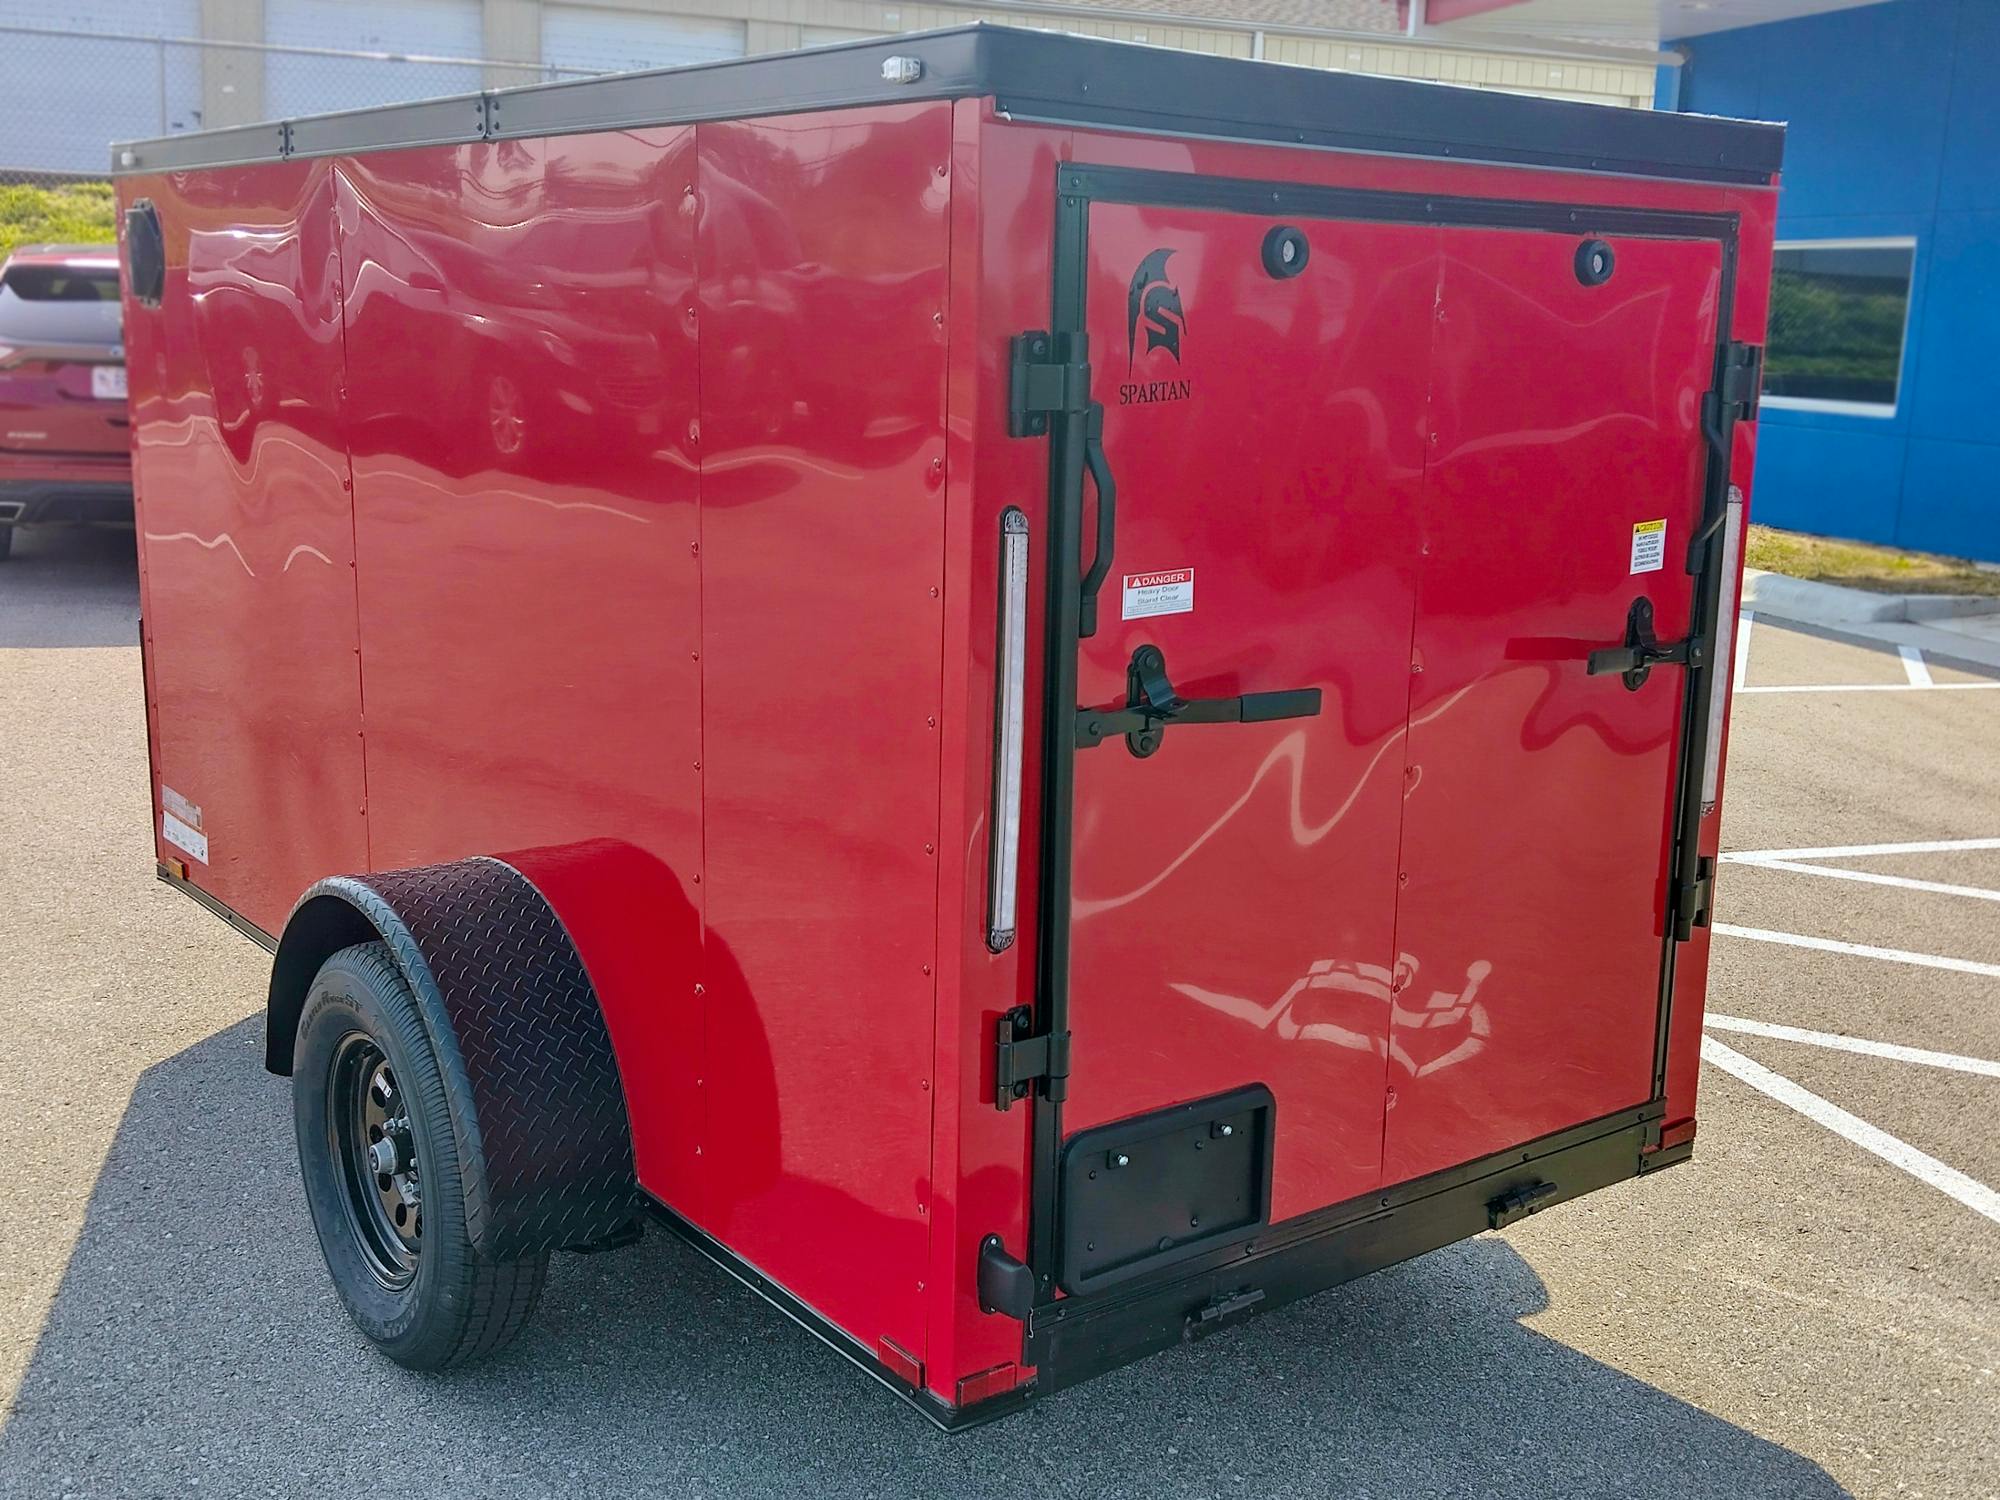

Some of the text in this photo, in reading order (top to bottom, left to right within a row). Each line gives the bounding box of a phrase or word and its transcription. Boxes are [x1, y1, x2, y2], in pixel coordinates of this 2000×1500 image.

[1119, 380, 1191, 405] SPARTAN
[1142, 573, 1185, 587] DANGER
[1137, 585, 1180, 596] Heavy Door
[1160, 594, 1180, 602] Clear
